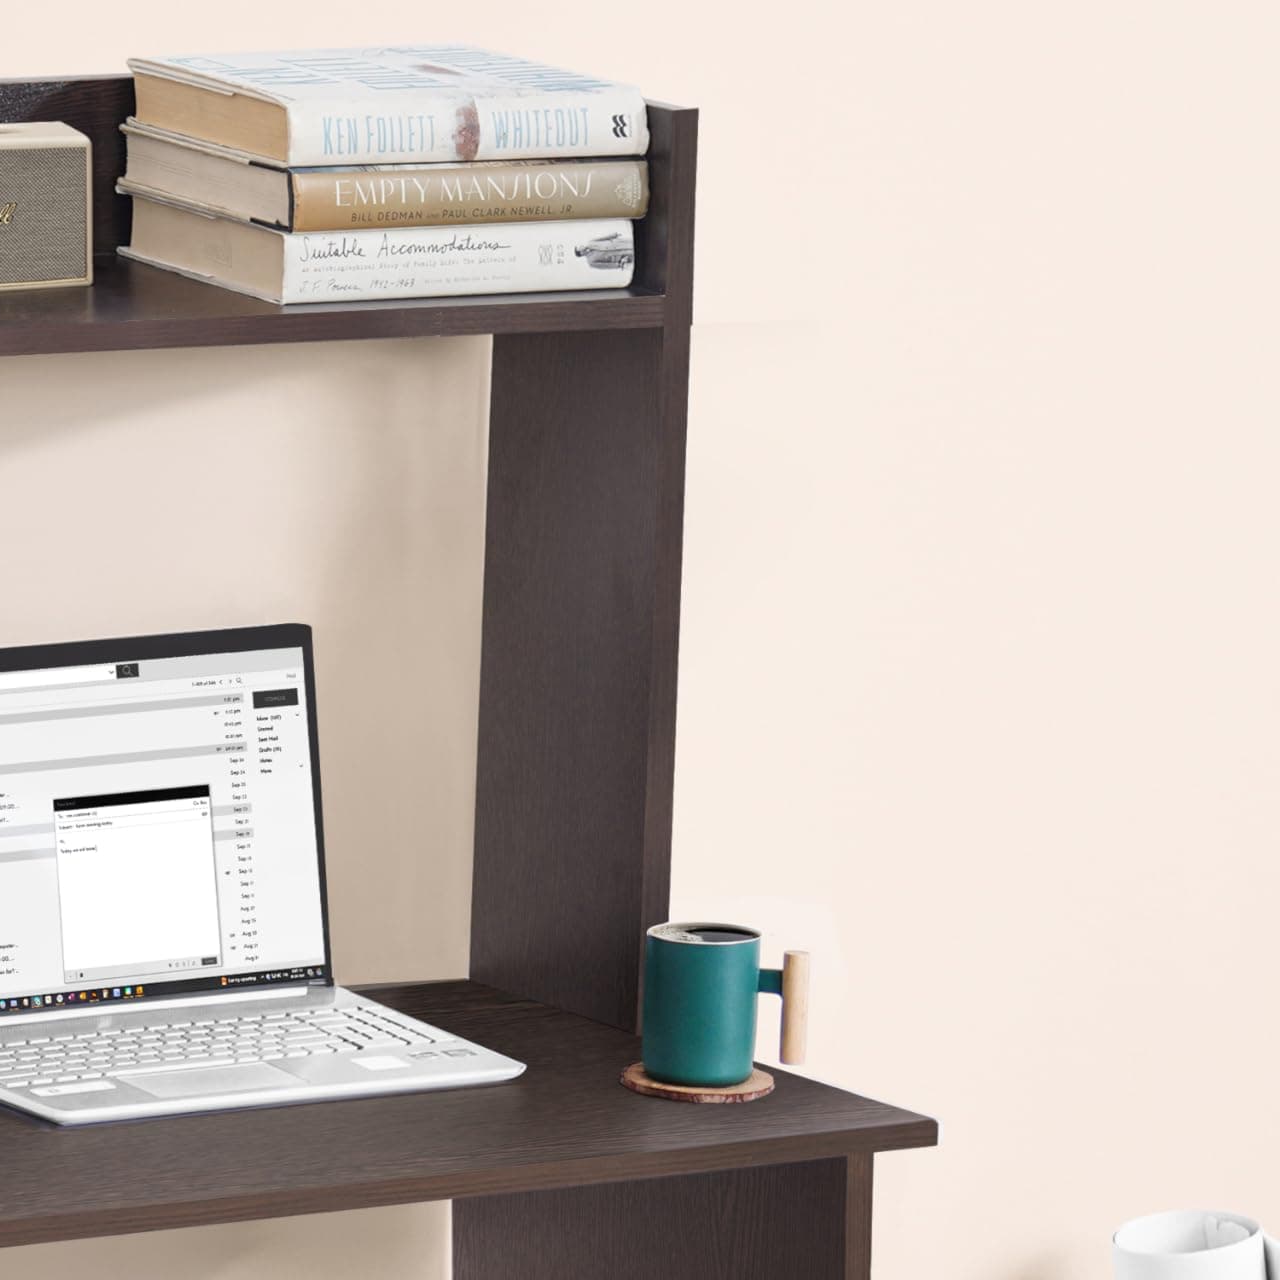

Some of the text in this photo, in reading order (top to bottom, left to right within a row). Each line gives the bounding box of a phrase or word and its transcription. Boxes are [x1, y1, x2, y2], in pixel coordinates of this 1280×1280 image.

[323, 114, 436, 155] KEN FOLLETT
[491, 107, 590, 149] WHITEOUT
[335, 176, 429, 207] EMPTY
[440, 170, 596, 201] MANSIONS
[351, 211, 373, 223] BILL
[377, 210, 423, 222] DEDMAN
[441, 208, 468, 219] PAUL
[472, 206, 508, 218] CLARK
[298, 233, 367, 263] Suitable
[377, 232, 512, 259] Accommodations
